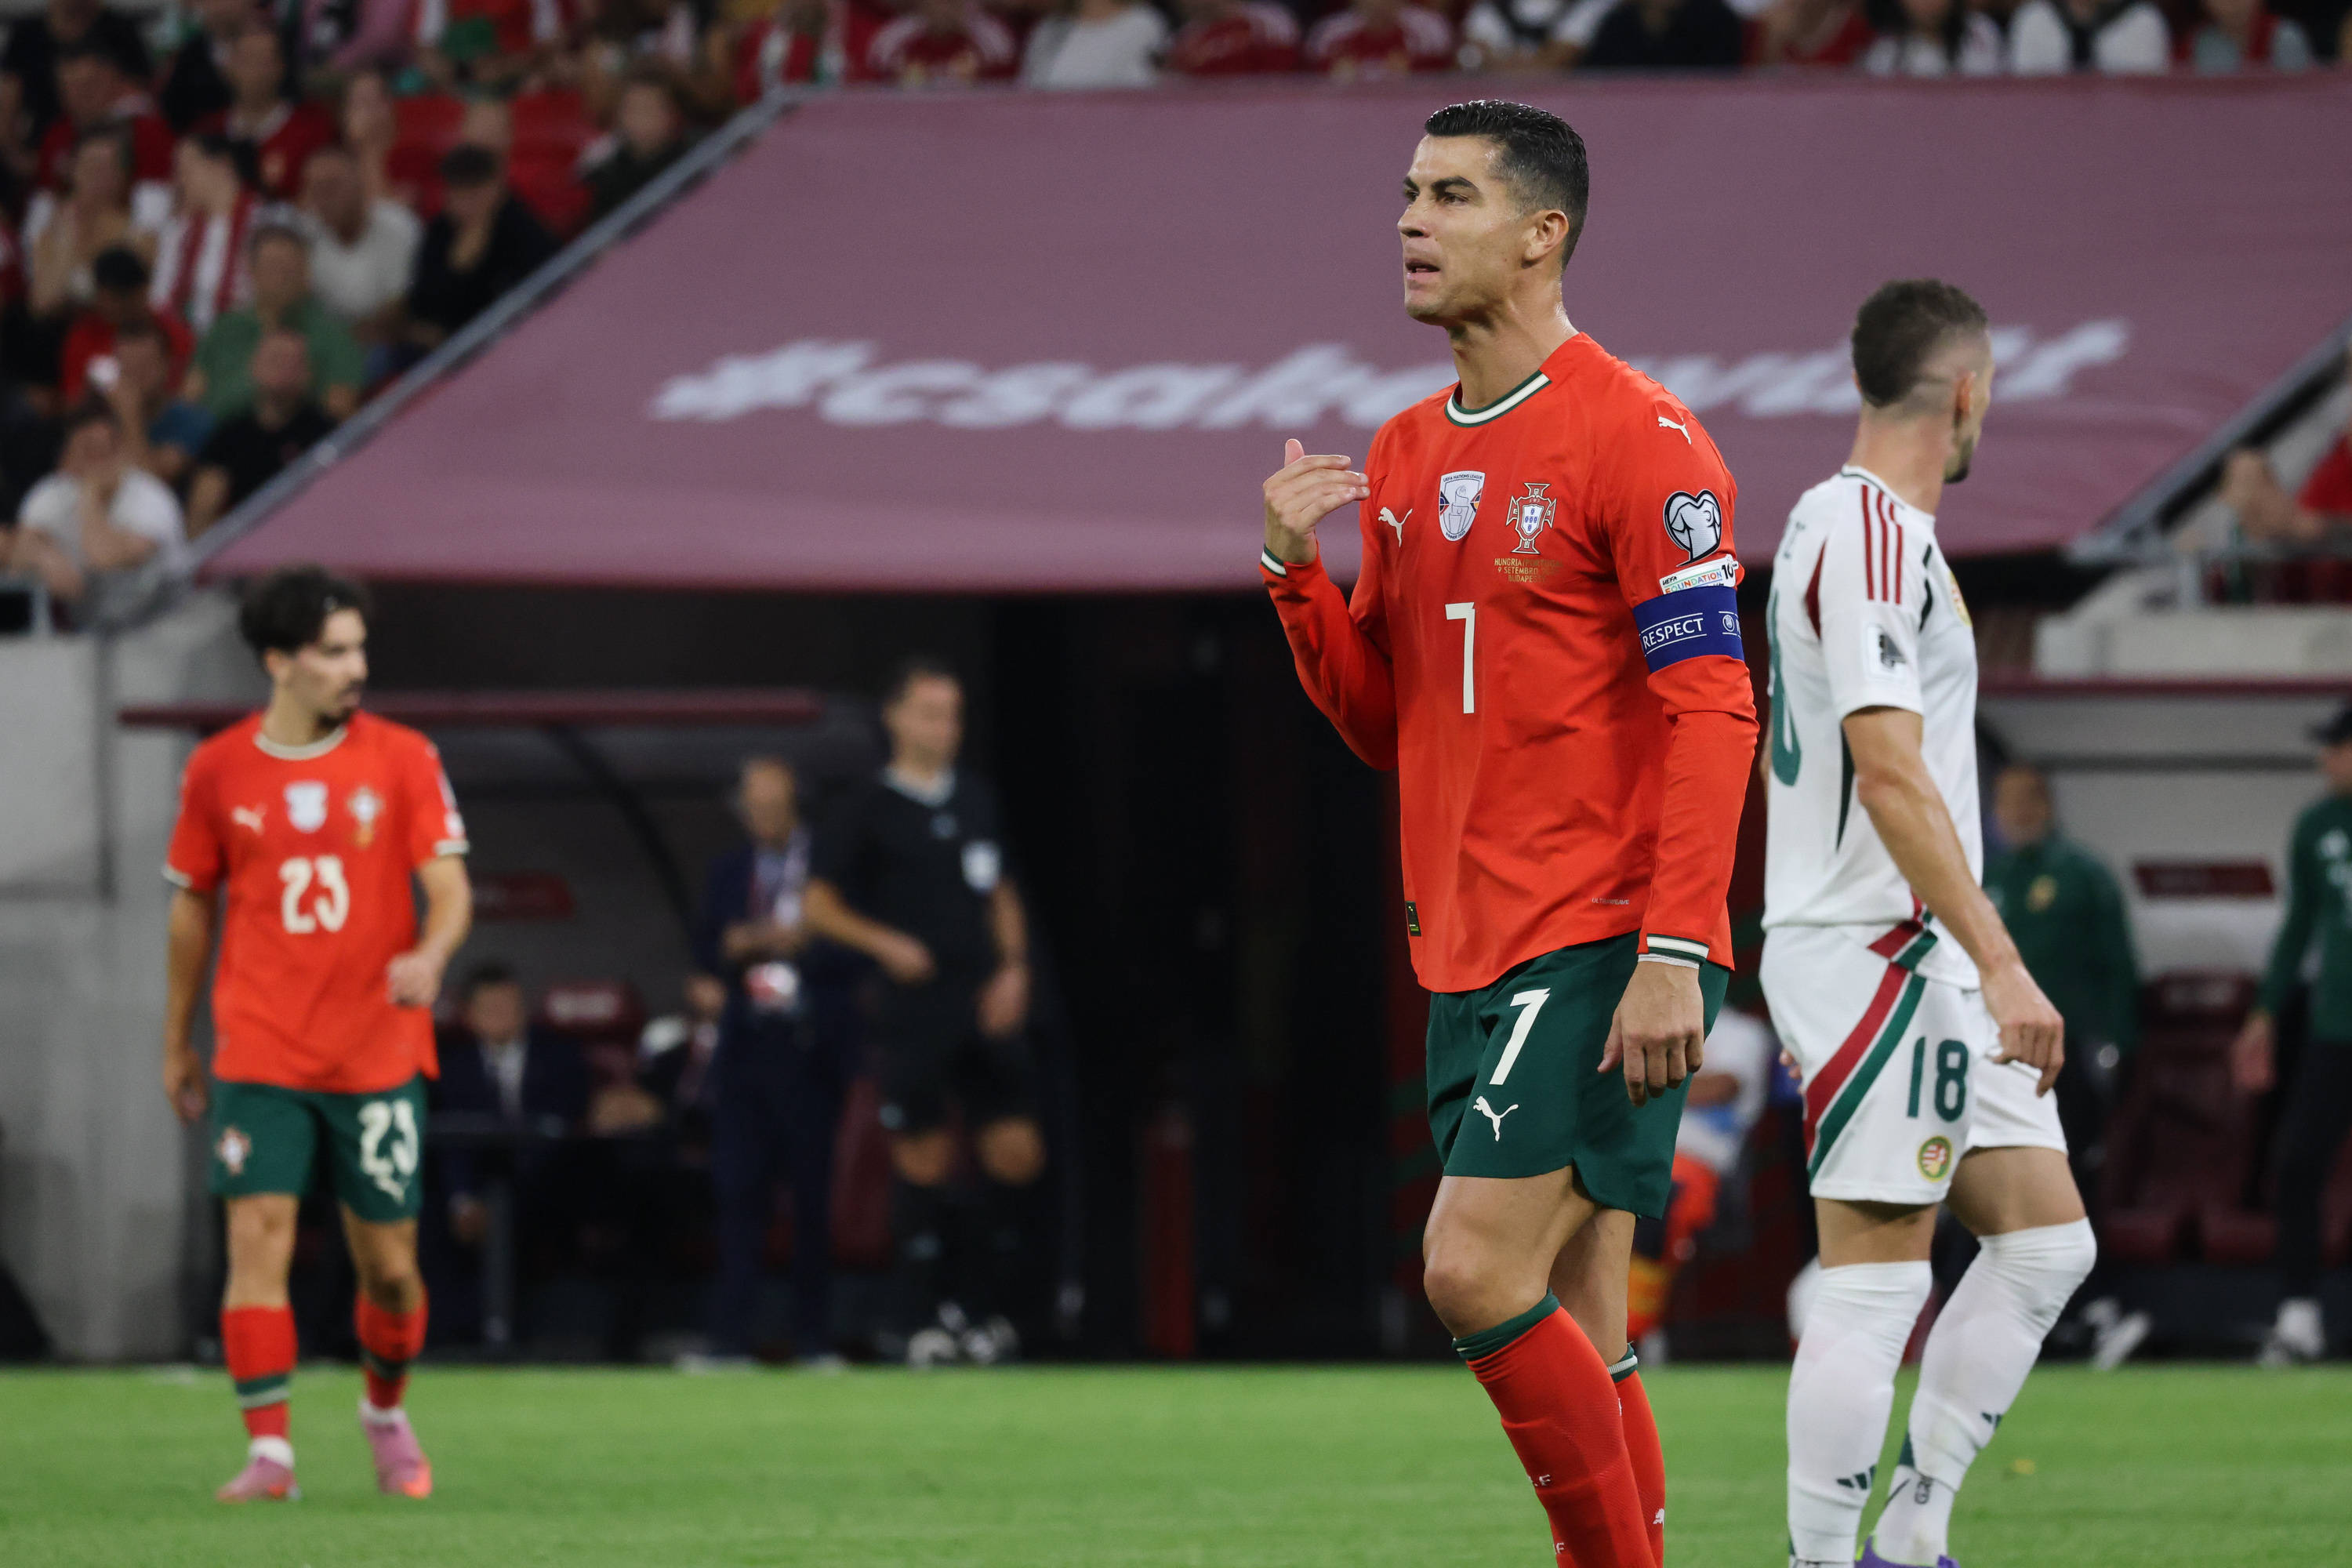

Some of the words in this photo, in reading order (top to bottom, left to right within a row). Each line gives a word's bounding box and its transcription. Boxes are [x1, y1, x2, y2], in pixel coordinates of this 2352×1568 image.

[1504, 567, 1538, 575] SETEMBRO
[1662, 575, 1677, 586] UEFA
[1665, 571, 1722, 593] FOUNDATION
[1445, 601, 1475, 713] 7
[1642, 618, 1704, 650] RESPECT
[279, 855, 350, 934] 23
[1489, 987, 1551, 1085] 7
[1906, 1036, 1969, 1123] 18
[358, 1099, 419, 1178] 23
